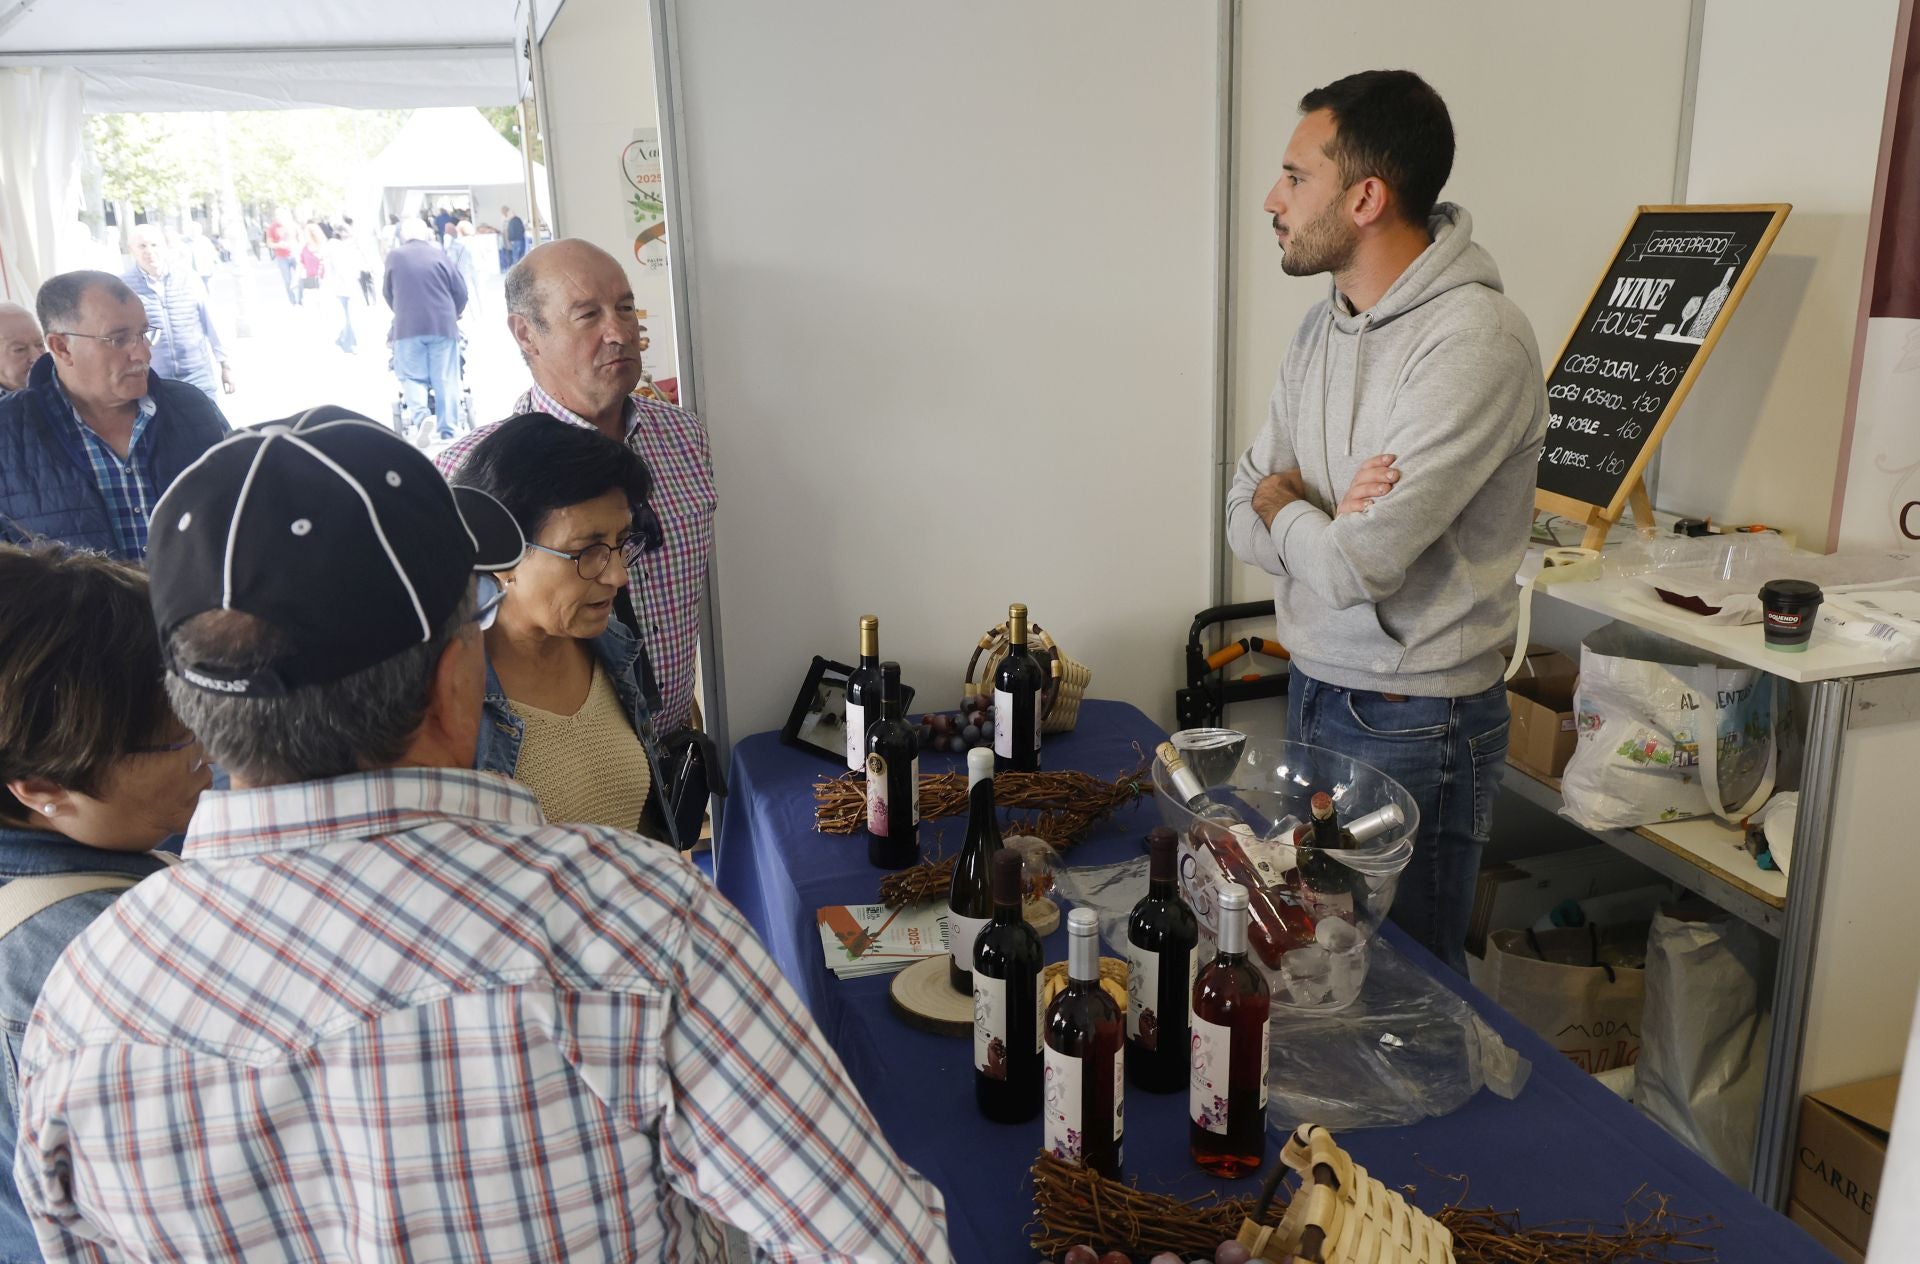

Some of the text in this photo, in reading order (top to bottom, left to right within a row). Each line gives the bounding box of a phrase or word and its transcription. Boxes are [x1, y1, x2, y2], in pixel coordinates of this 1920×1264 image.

[1647, 236, 1728, 254] CARREPRADO
[1607, 276, 1677, 311] WINE
[1591, 311, 1657, 339] HOUSE
[1566, 416, 1601, 435] ROBLE
[1768, 613, 1799, 623] OQUENDO
[907, 927, 921, 945] 2025
[1556, 1020, 1640, 1039] MODA
[1799, 1146, 1874, 1216] CARRE
